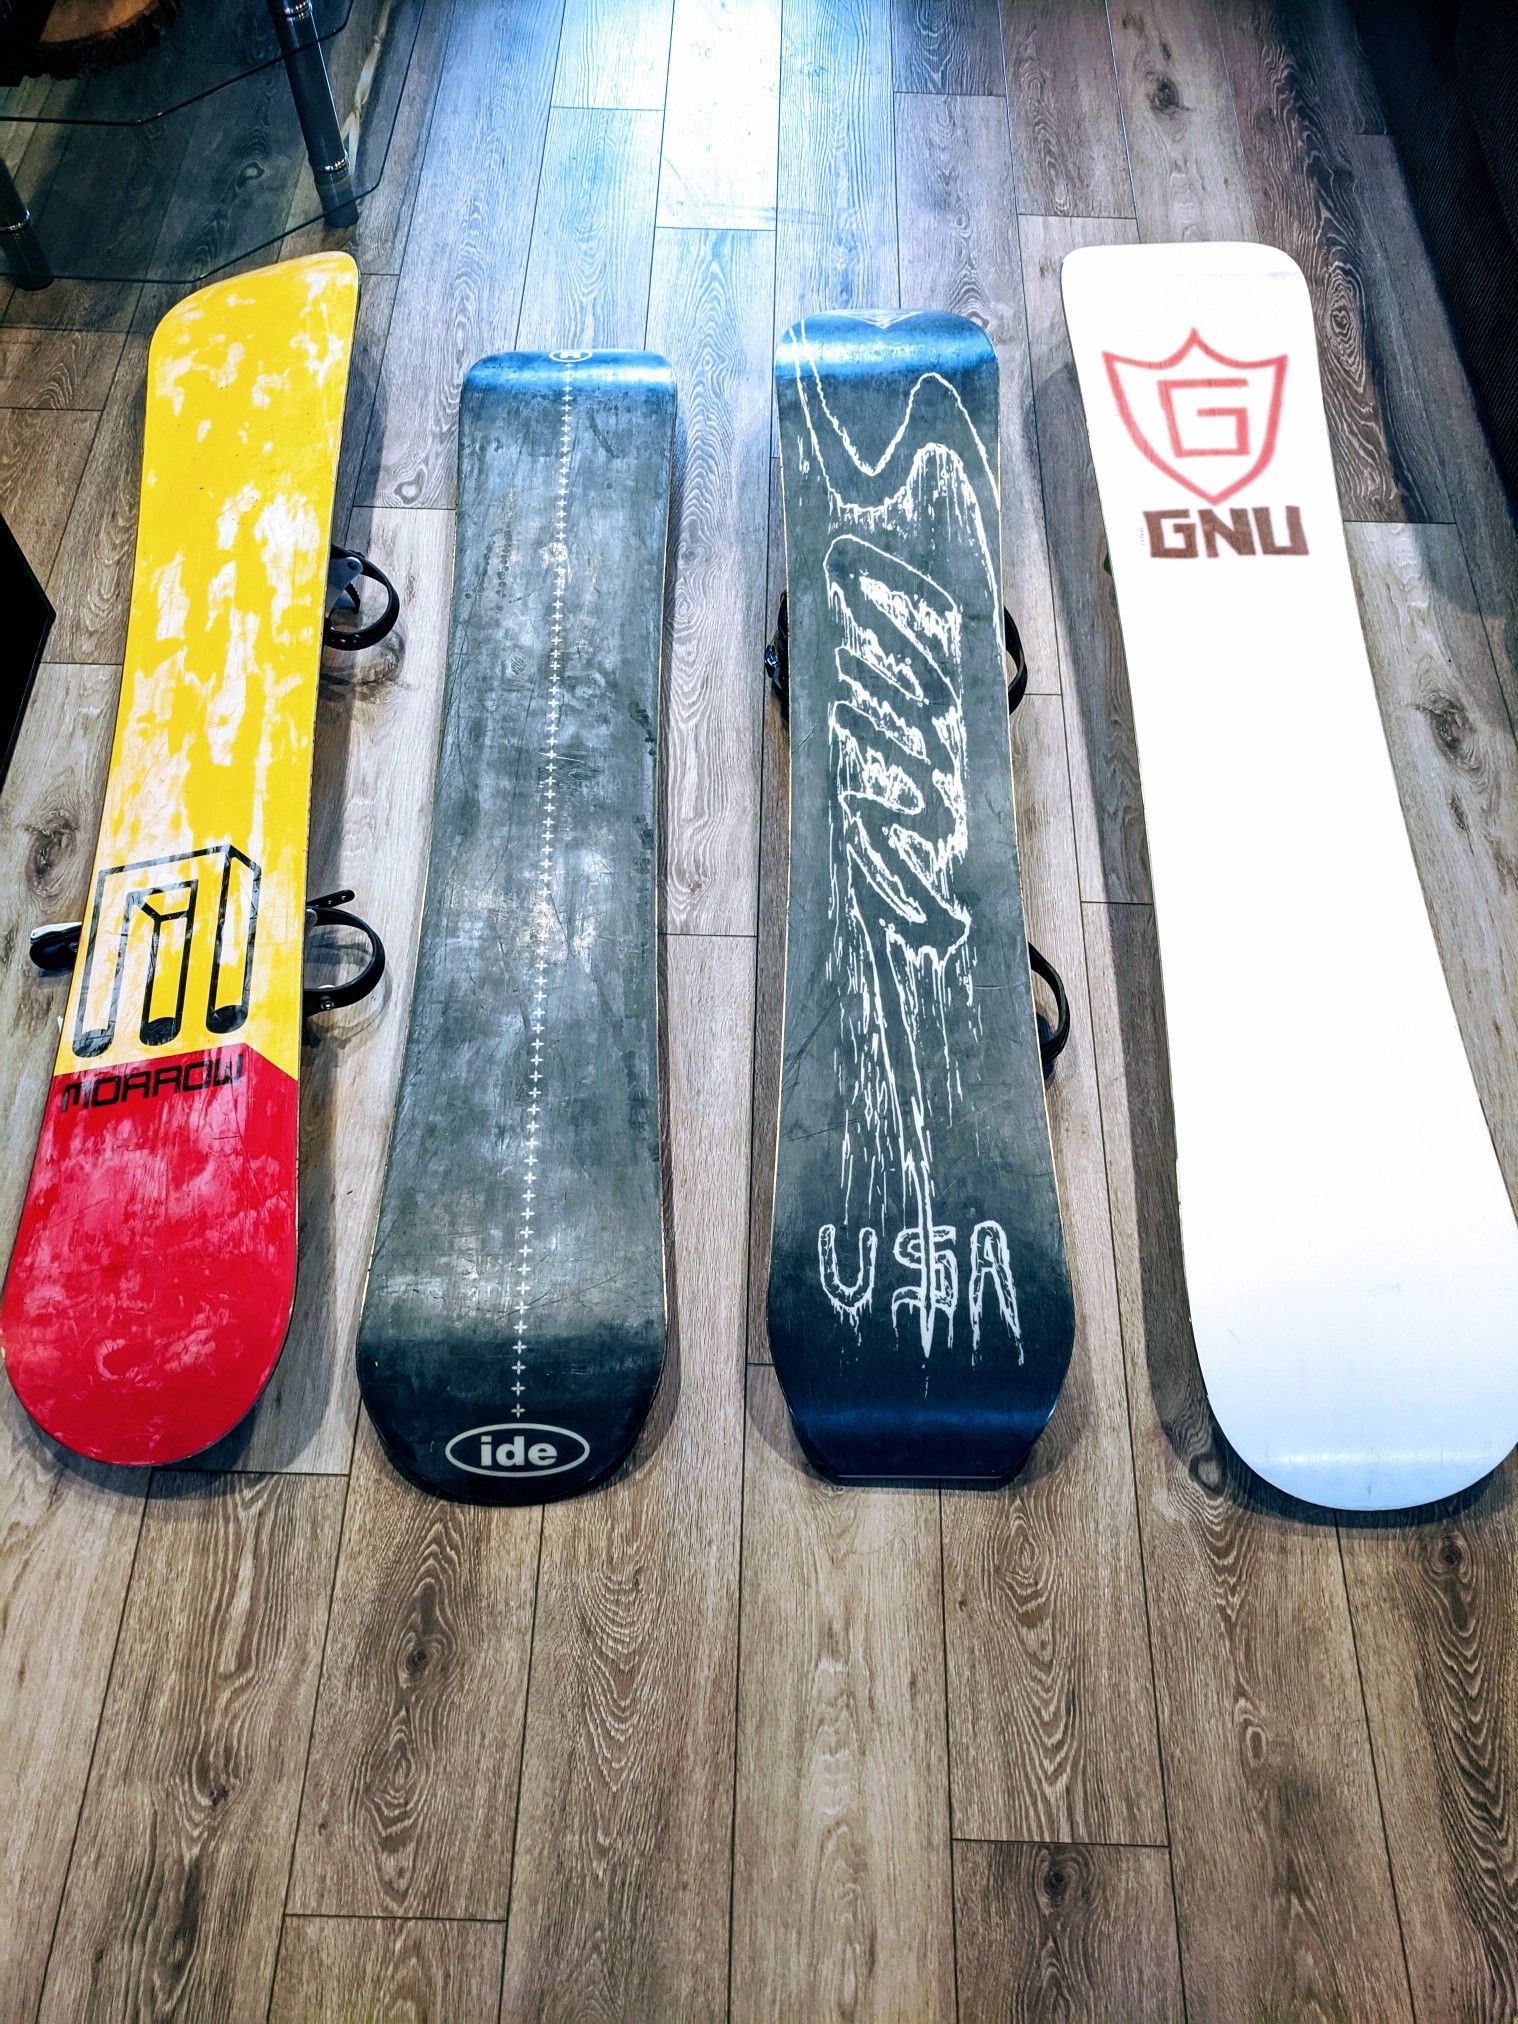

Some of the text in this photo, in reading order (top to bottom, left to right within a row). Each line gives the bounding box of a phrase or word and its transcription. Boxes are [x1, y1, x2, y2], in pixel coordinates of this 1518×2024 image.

[1142, 505, 1309, 558] GNU
[61, 1053, 245, 1113] MORROW
[818, 1220, 1024, 1360] USA
[480, 1435, 558, 1467] ide
